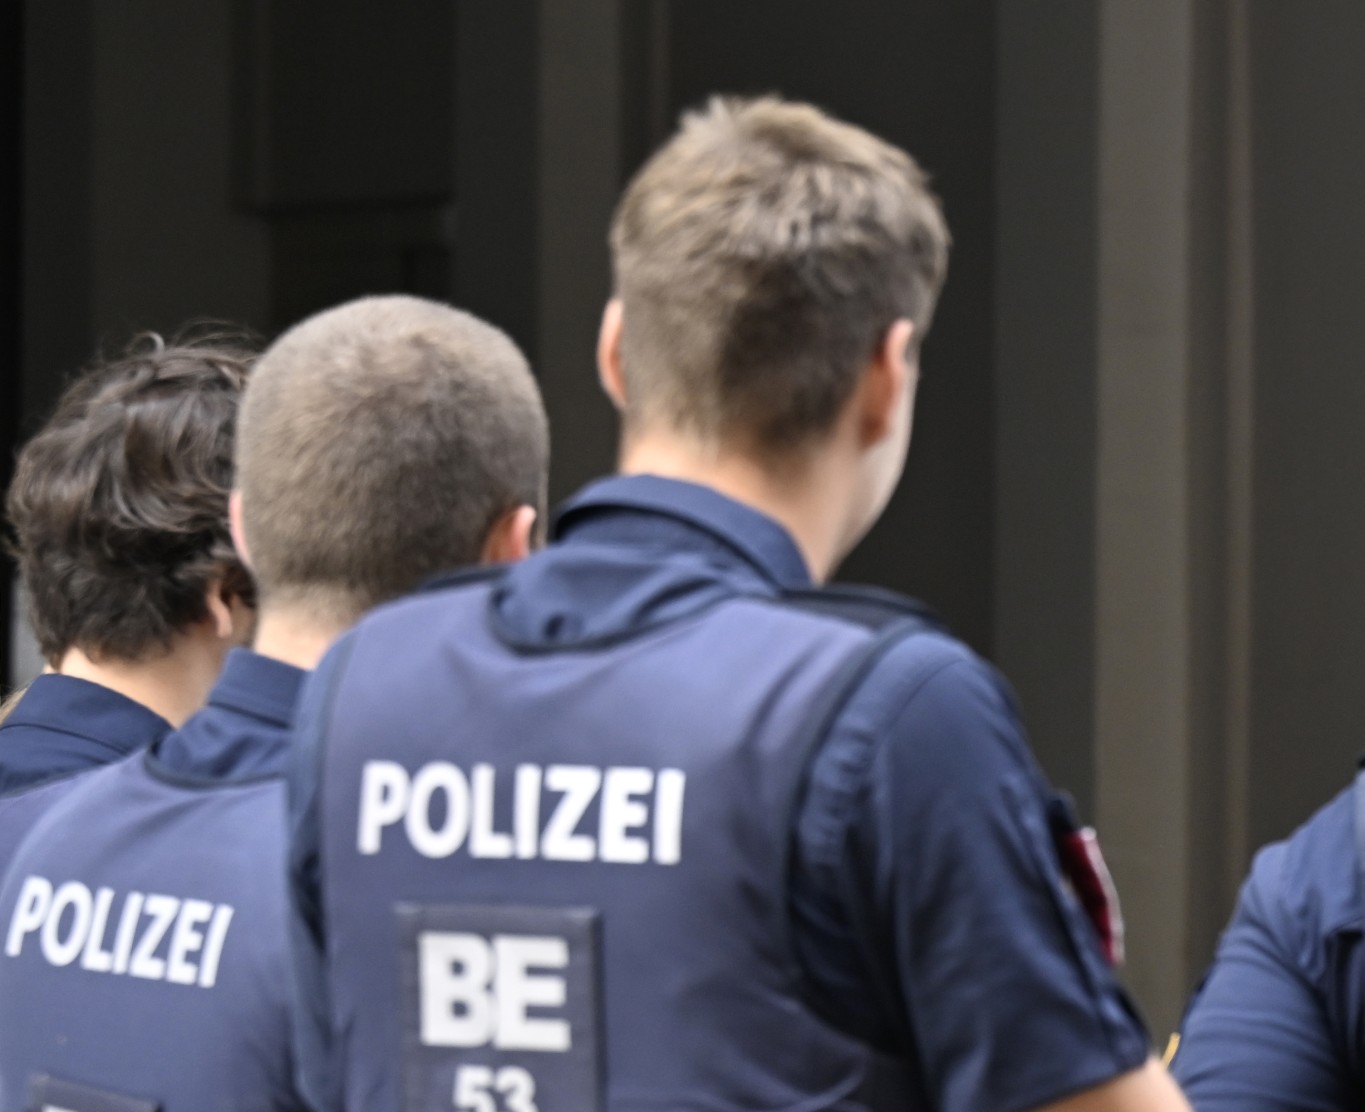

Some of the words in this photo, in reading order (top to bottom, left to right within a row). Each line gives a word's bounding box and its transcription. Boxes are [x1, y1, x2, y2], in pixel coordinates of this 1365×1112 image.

[358, 760, 687, 865] POLIZEI
[4, 875, 235, 989] POLIZEI
[419, 932, 571, 1052] BE
